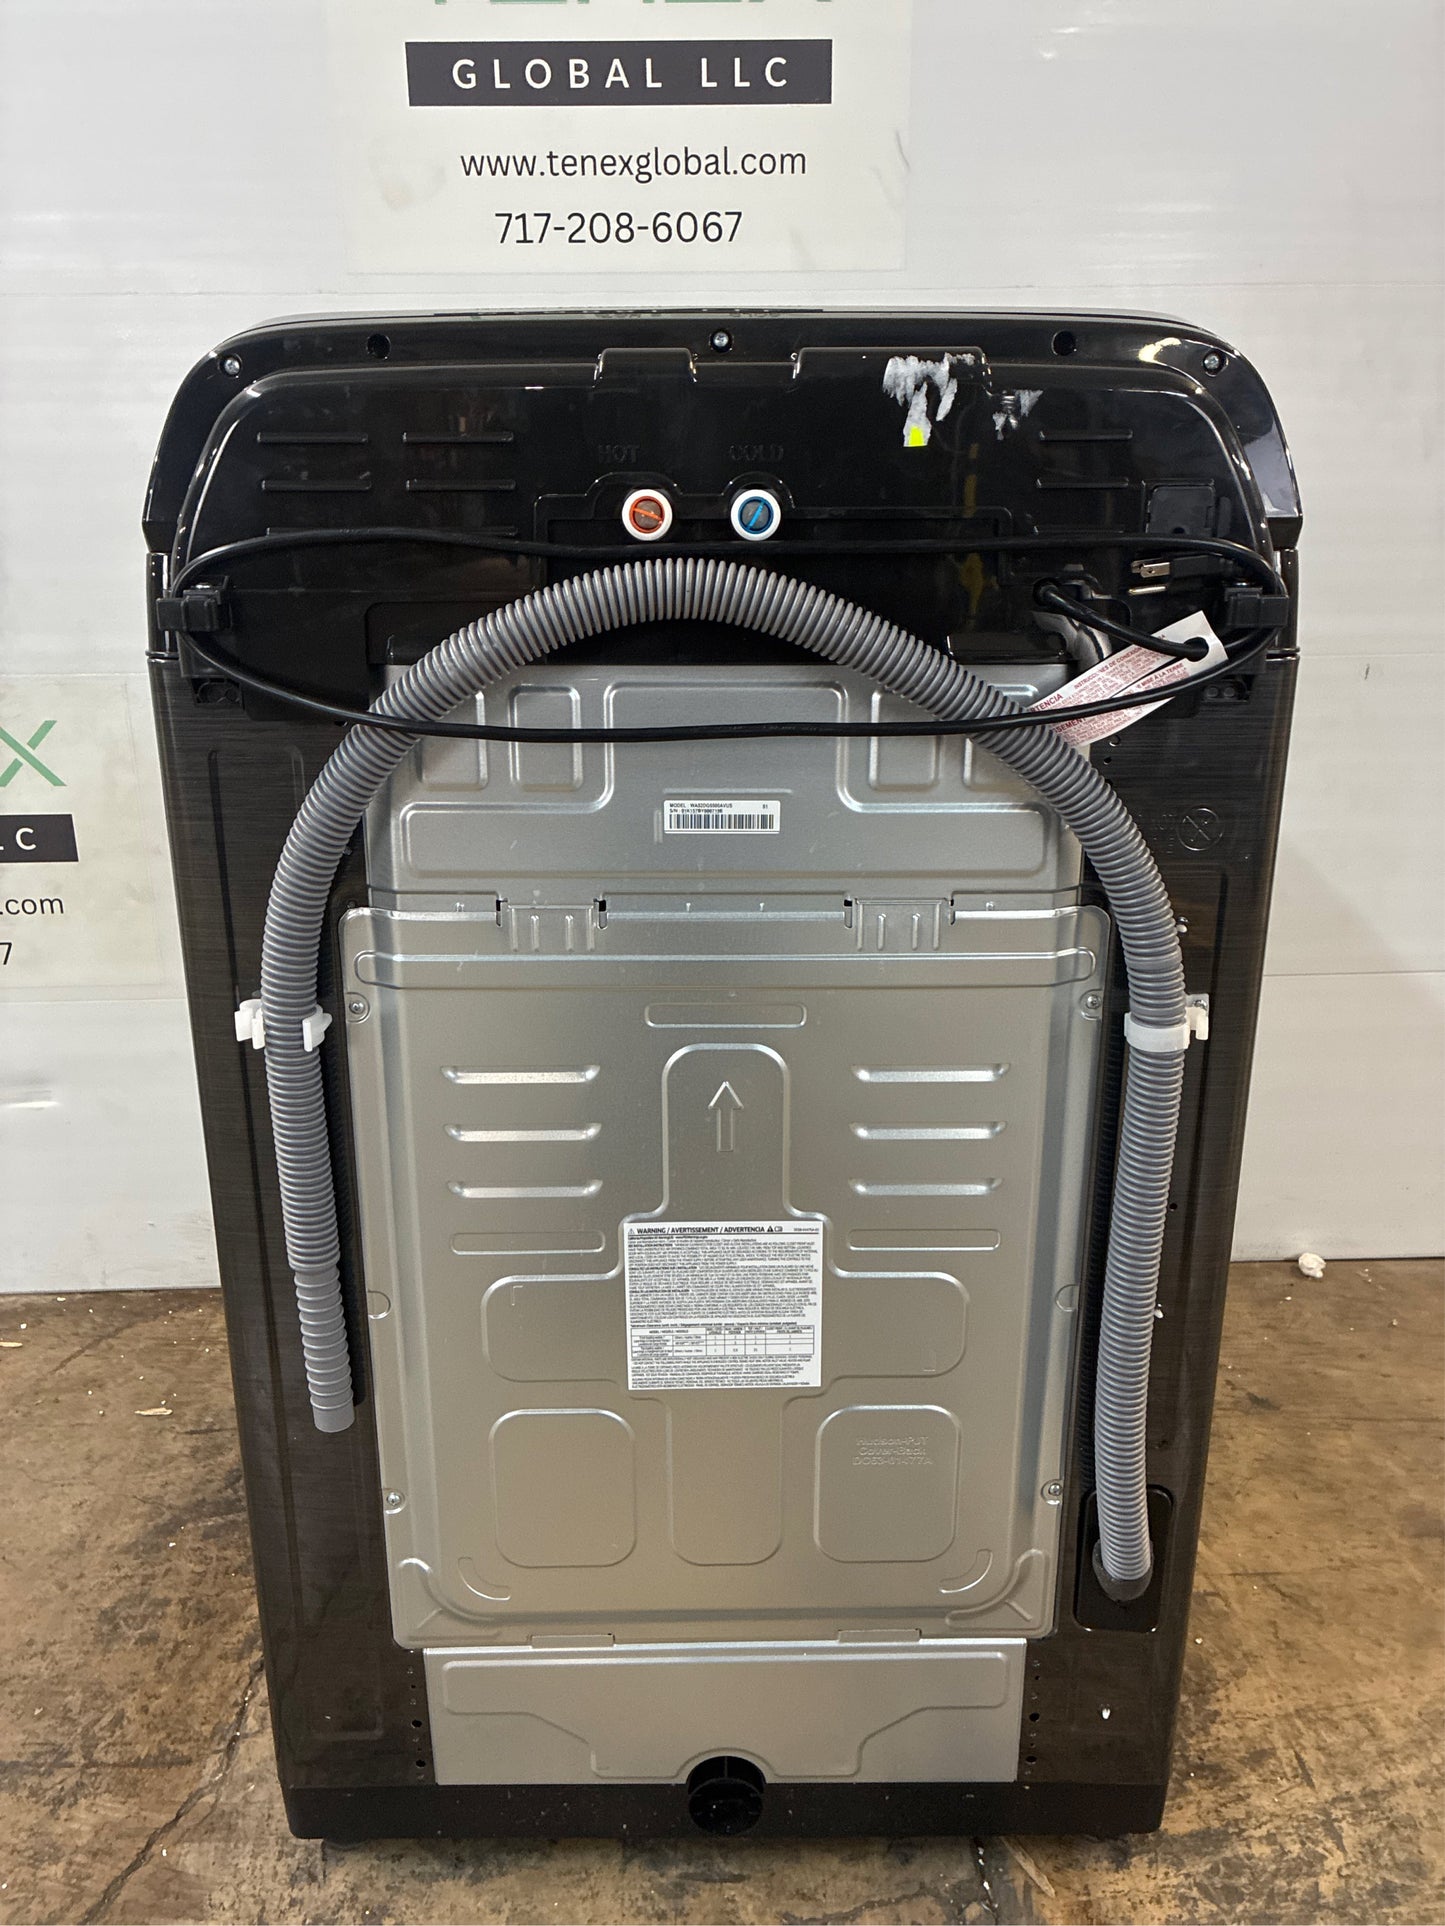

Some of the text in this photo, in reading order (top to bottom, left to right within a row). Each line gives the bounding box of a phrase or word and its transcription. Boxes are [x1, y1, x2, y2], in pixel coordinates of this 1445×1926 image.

[452, 56, 787, 90] GLOBAL LLC
[460, 146, 806, 184] www.tenexglobal.com
[495, 211, 744, 244] 717-208-6067
[597, 445, 784, 463] HOT COLD
